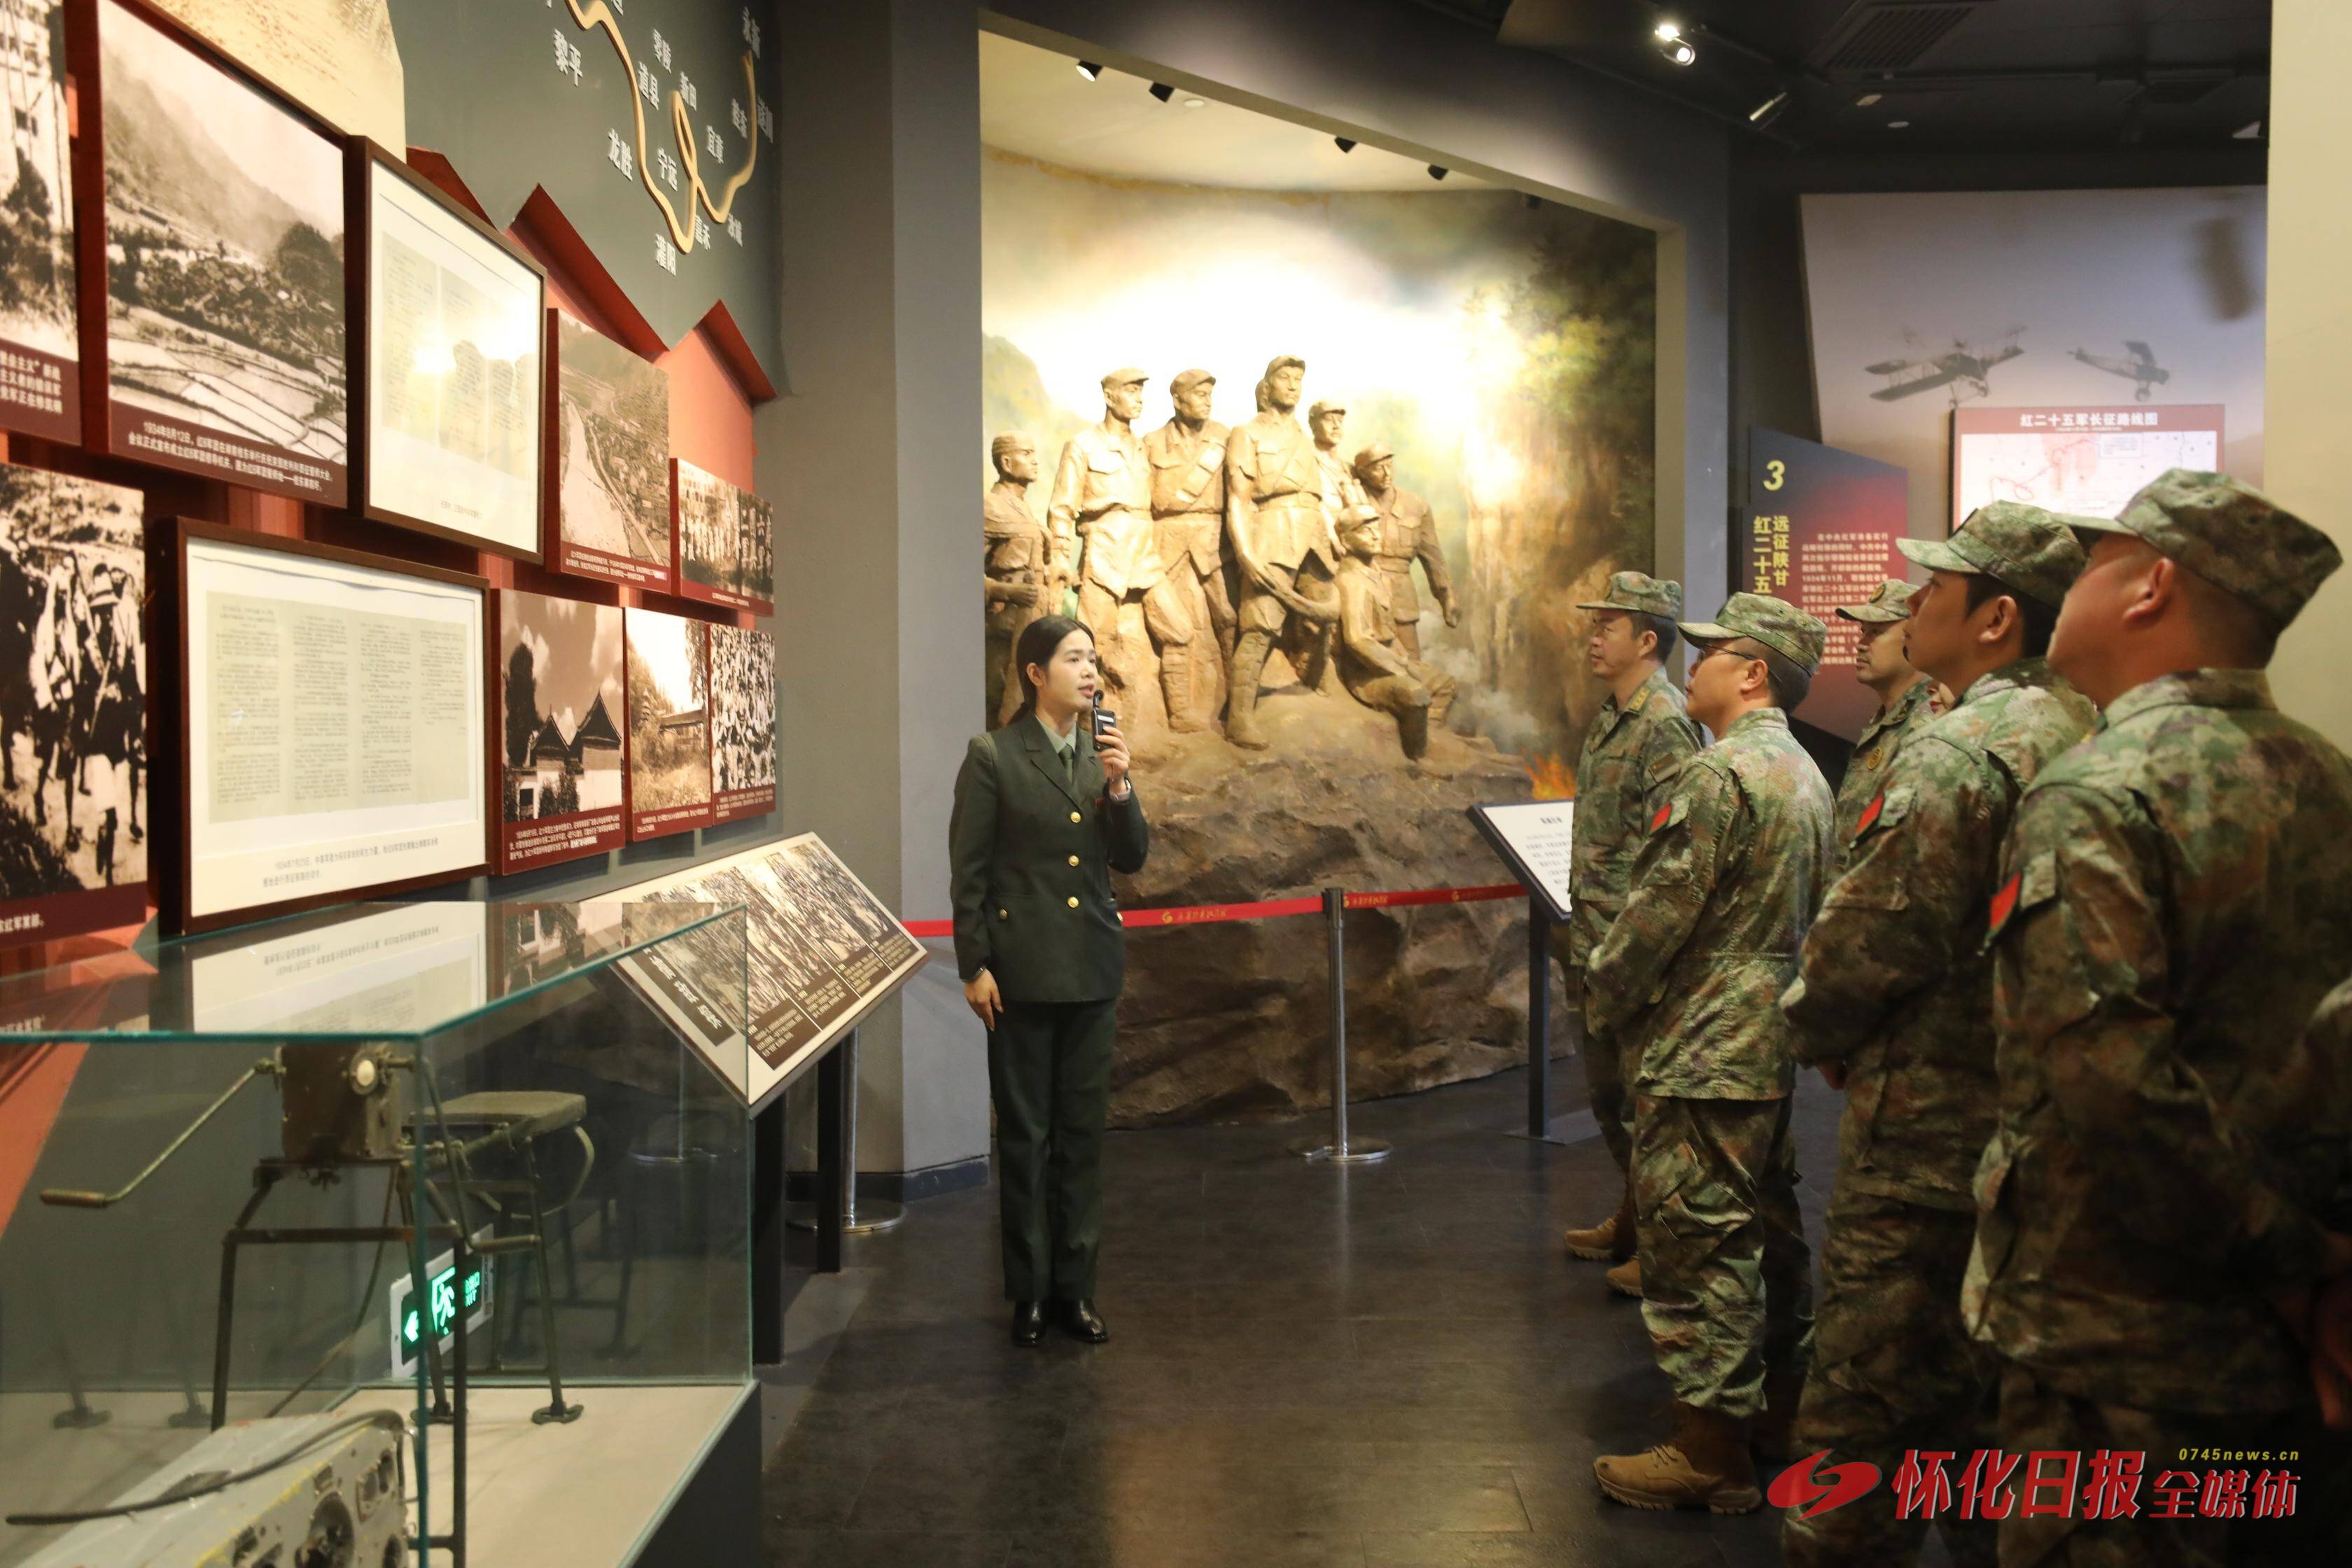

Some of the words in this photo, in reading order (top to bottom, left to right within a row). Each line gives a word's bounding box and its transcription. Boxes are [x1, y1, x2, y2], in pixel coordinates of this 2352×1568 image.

[553, 27, 583, 87] 黎平
[638, 60, 659, 111] 道县
[607, 127, 633, 181] 龙胜
[2020, 412, 2158, 427] 红二十五军长征路线图
[1763, 459, 1785, 491] 3
[1753, 515, 1772, 594] 红二十五
[1772, 514, 1790, 587] 远征陕甘
